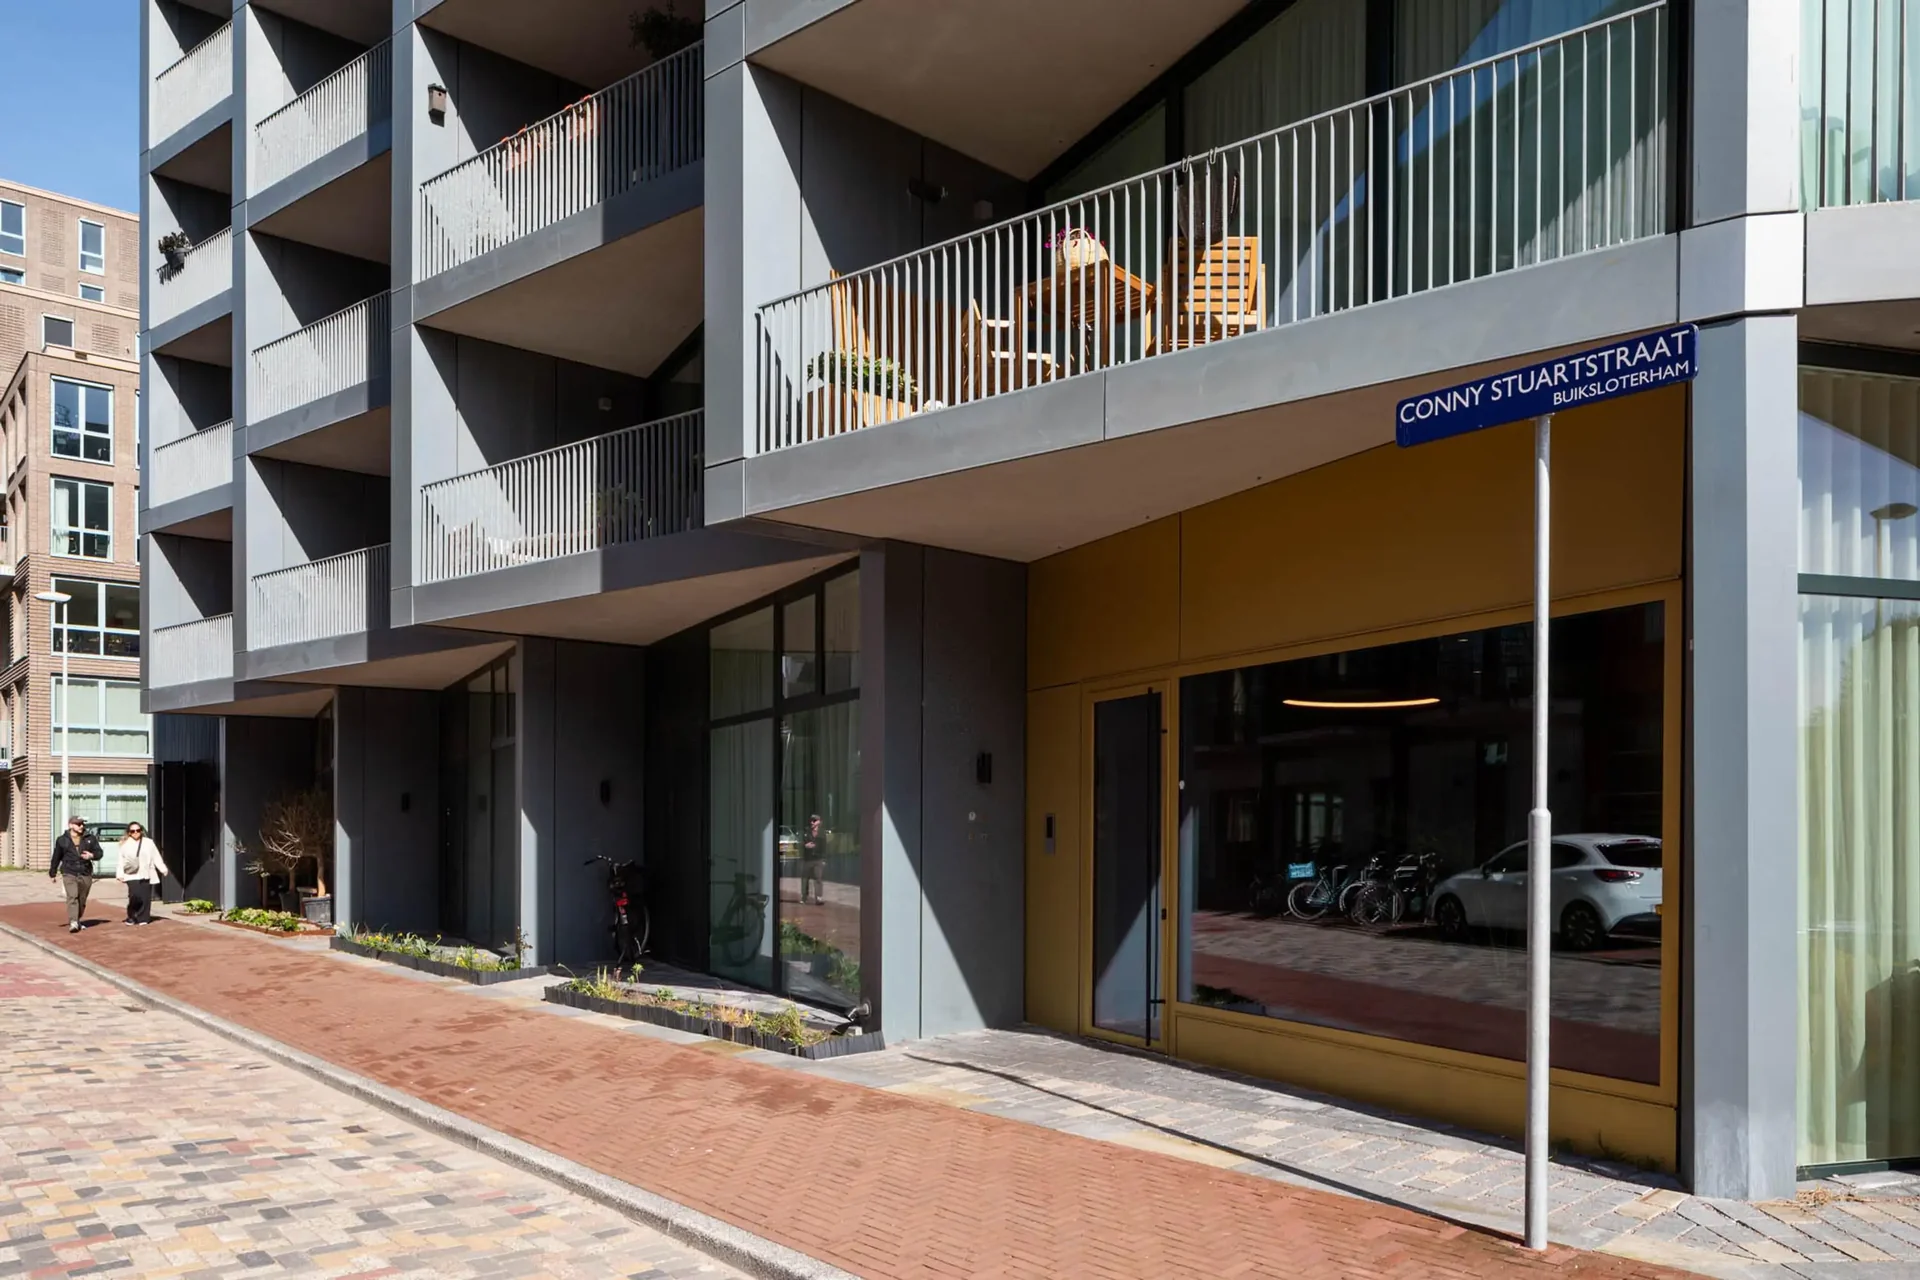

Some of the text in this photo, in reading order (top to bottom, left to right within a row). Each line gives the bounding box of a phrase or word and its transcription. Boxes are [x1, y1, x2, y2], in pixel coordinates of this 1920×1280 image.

[1400, 330, 1690, 424] CONNY STUARTSTRAAT
[1553, 360, 1689, 406] BUIKSLOTERHAM
